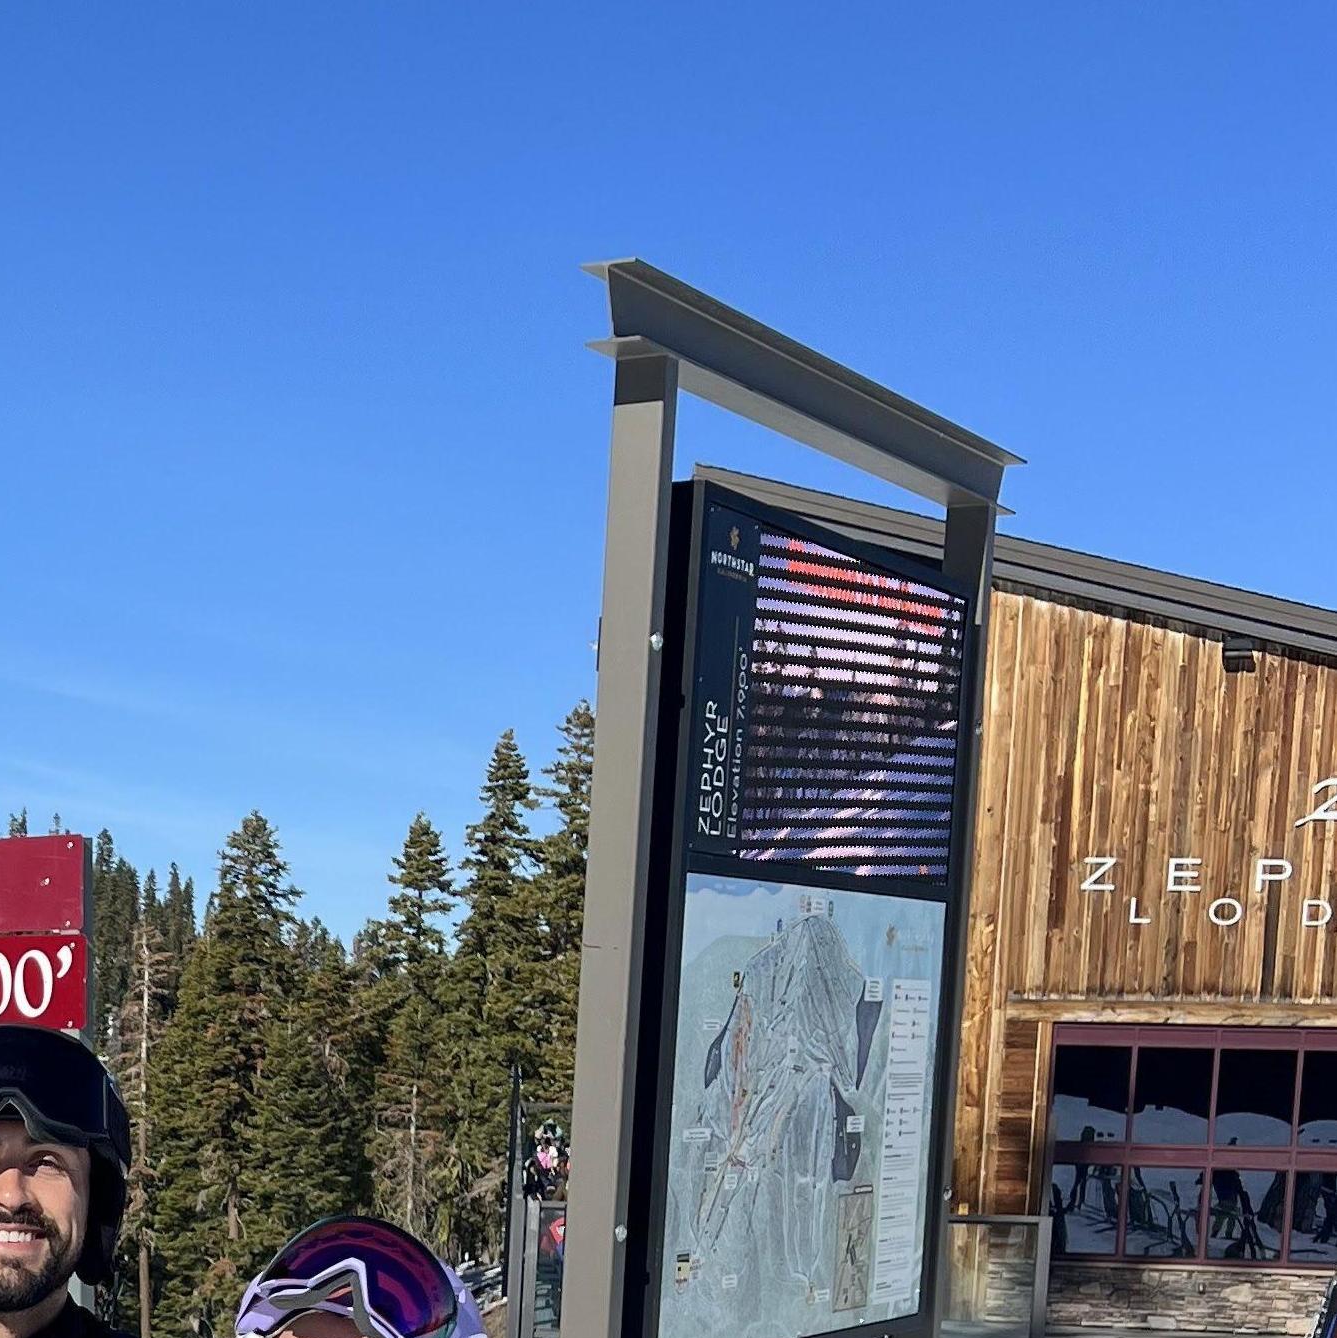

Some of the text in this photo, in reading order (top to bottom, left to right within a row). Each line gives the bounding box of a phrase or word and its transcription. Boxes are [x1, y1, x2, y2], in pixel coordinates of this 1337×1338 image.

[697, 700, 718, 836] ZEPHYR
[710, 714, 729, 836] LODGE
[726, 728, 743, 839] Elevation
